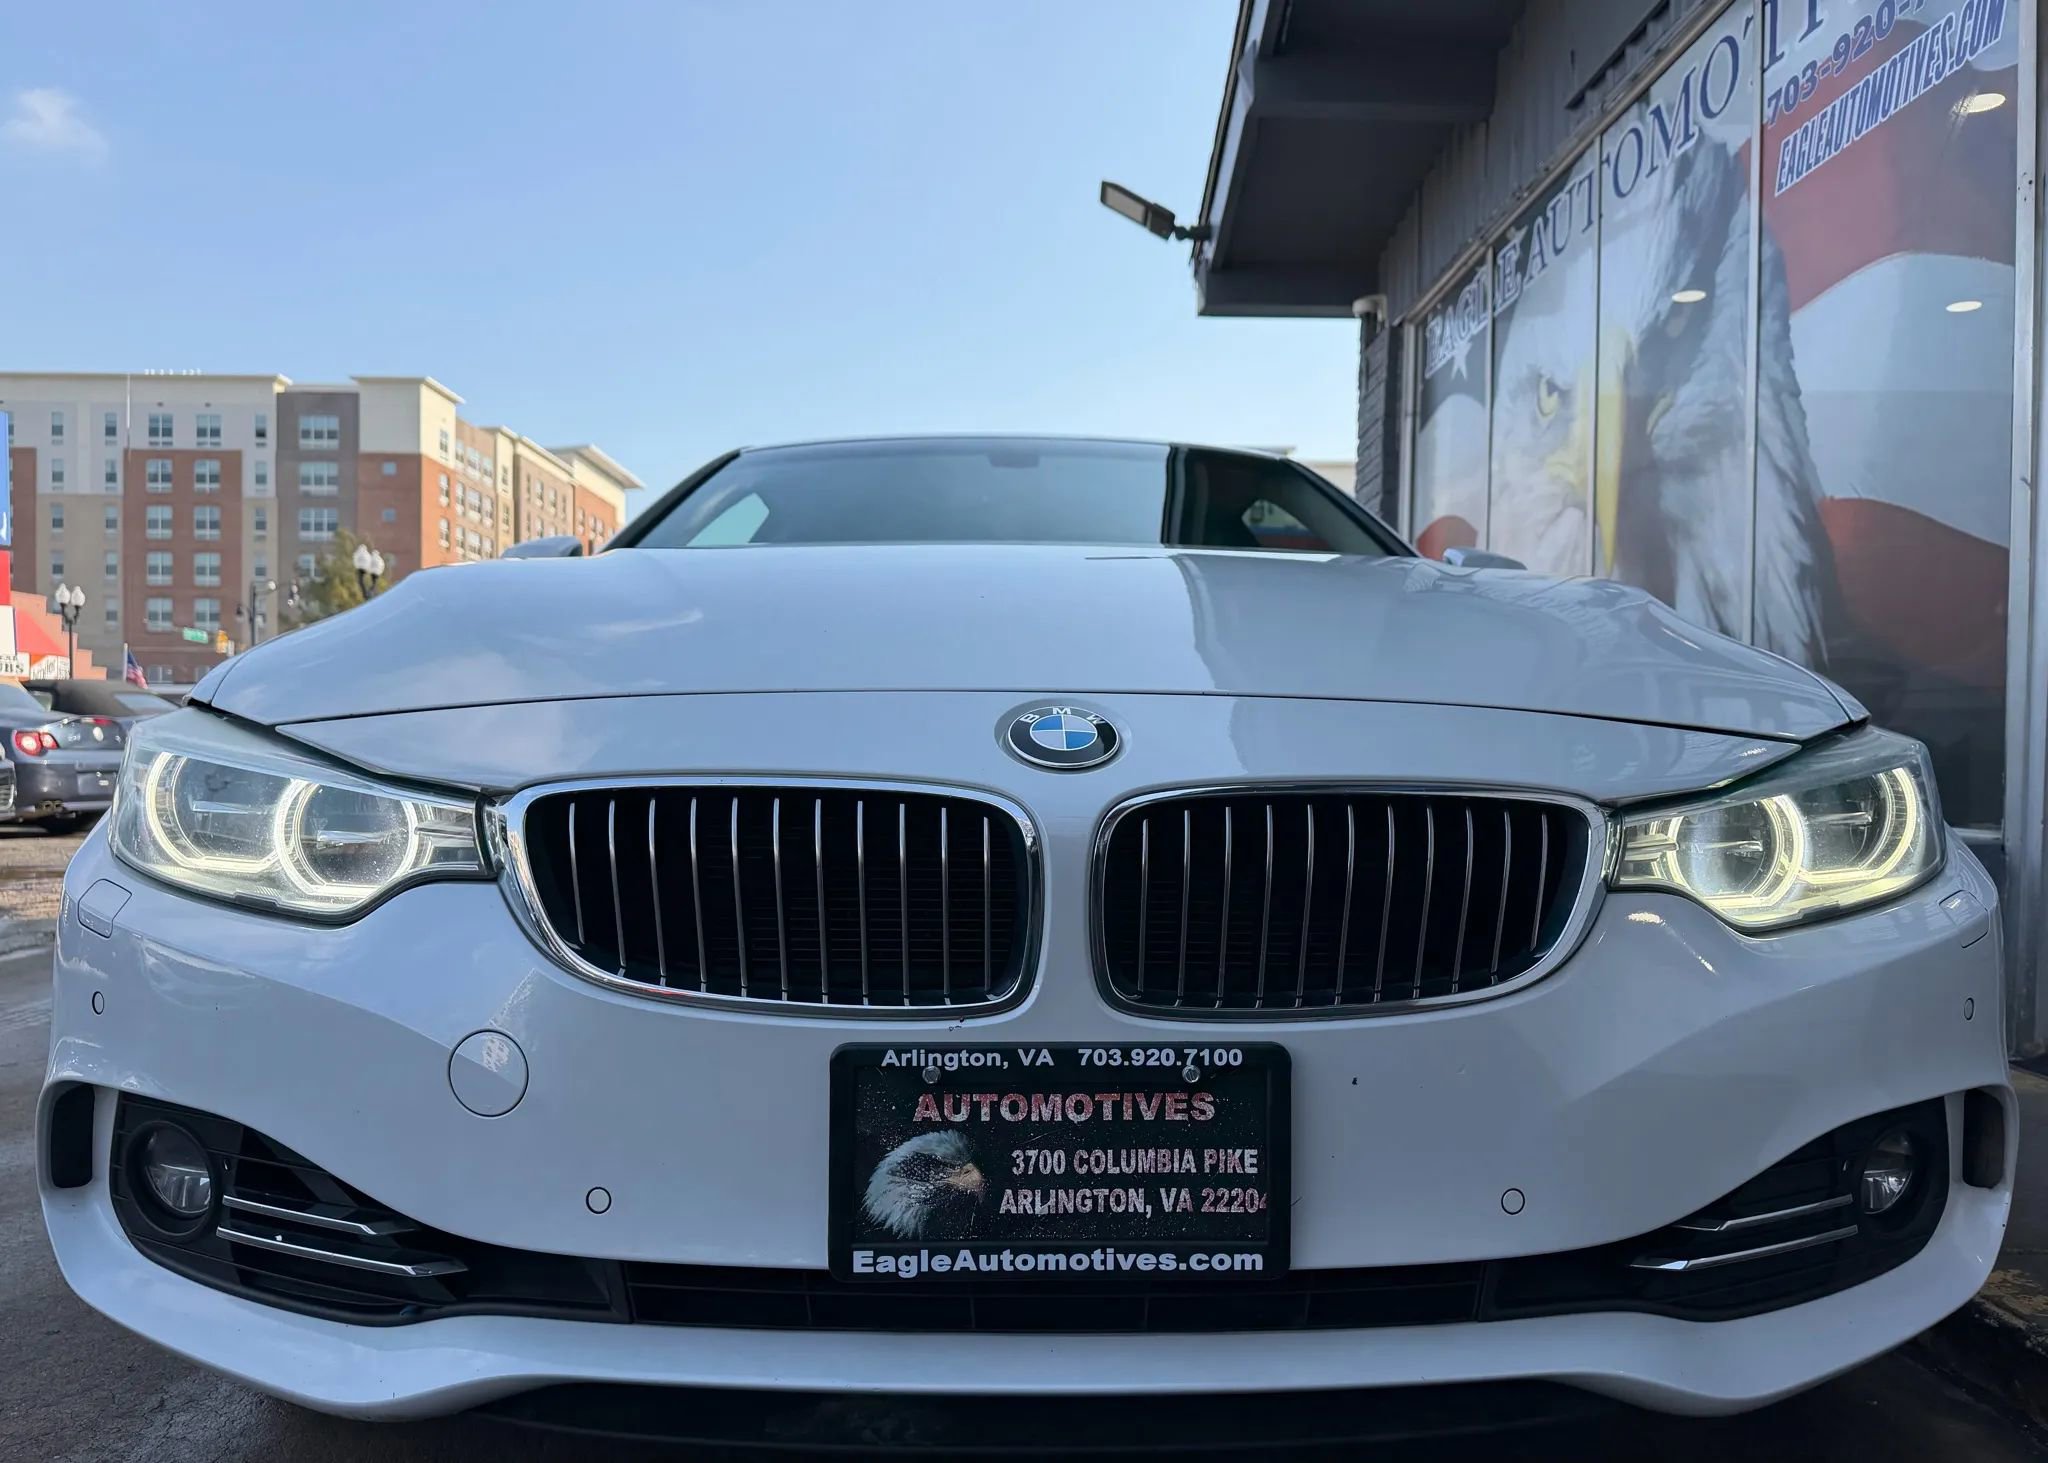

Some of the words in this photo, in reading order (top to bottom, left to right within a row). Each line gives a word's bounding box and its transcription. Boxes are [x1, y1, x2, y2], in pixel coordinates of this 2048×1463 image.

[1767, 0, 1926, 128] 703-920-
[1774, 0, 2007, 197] EAGLEAUTOMOTIVES.COM
[1425, 238, 1523, 379] EAGLE
[1019, 707, 1106, 725] BMW
[881, 1049, 1009, 1070] Arlington,
[1018, 1049, 1055, 1067] VA
[1078, 1048, 1244, 1067] 703.920.7100
[912, 1092, 1217, 1123] AUTOMOTIVES
[1011, 1149, 1067, 1176] 3700
[1073, 1148, 1198, 1176] COLUMBIA
[1203, 1148, 1259, 1175] PIKE
[1000, 1187, 1153, 1219] ARLINGTON,
[1159, 1187, 1195, 1214] VA
[851, 1248, 1265, 1279] EagleAutomotives.com
